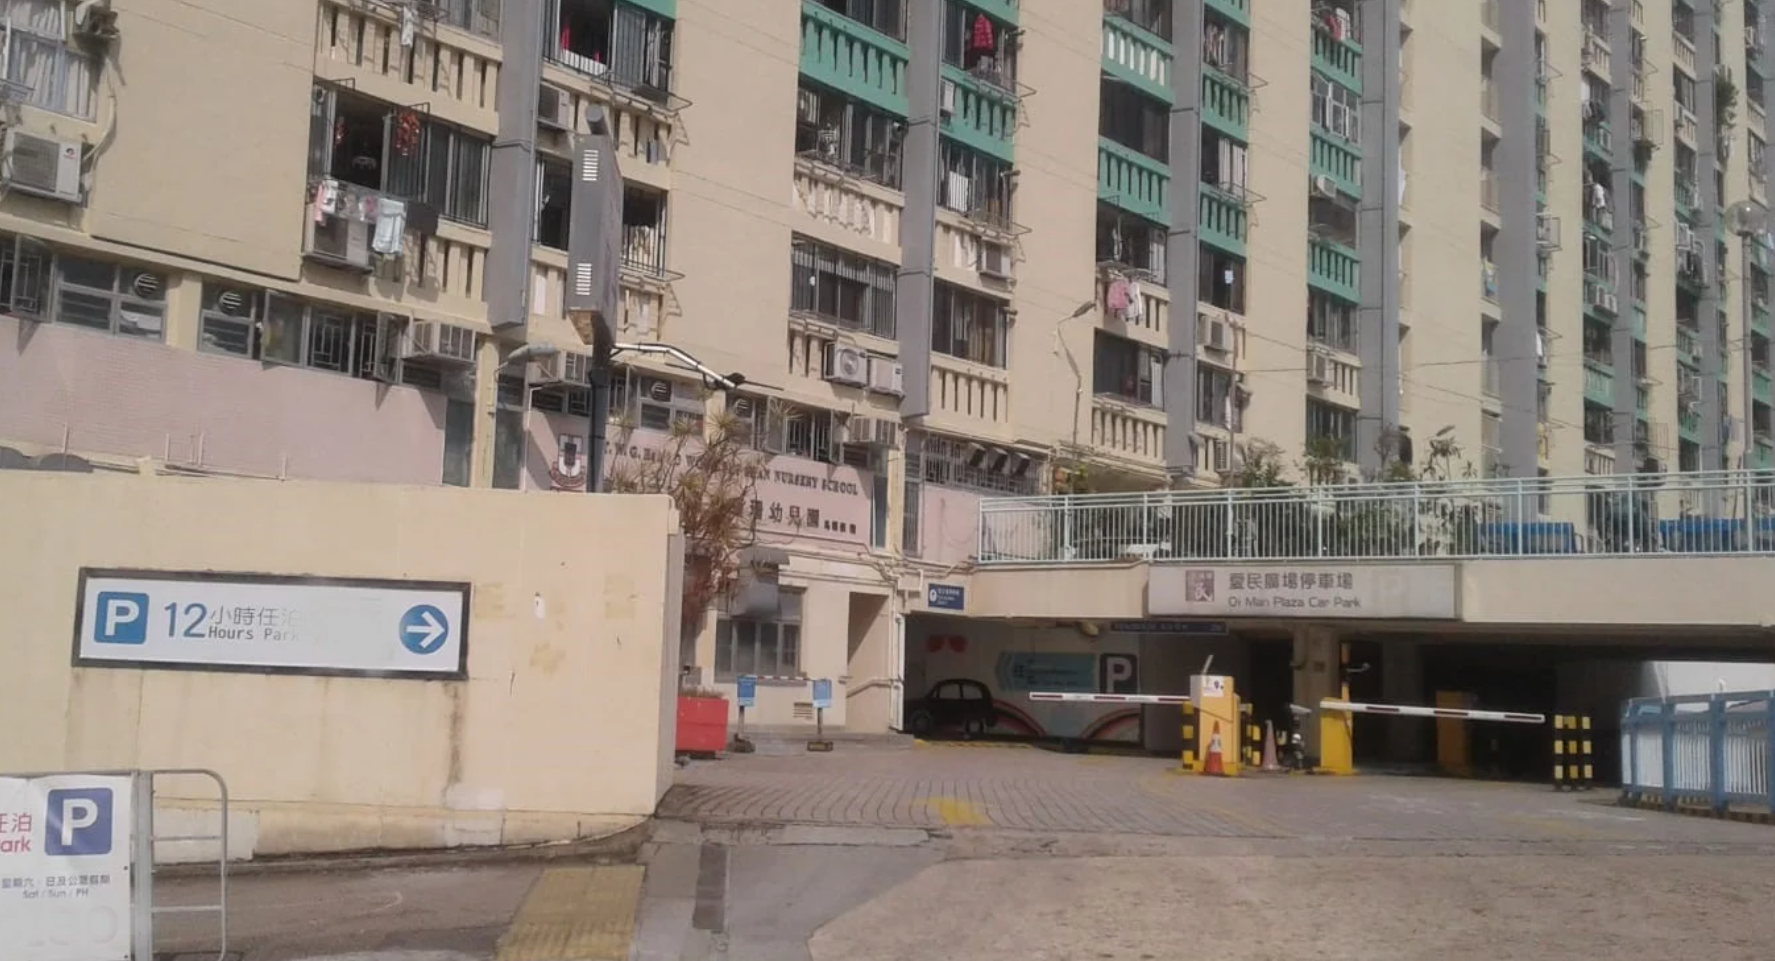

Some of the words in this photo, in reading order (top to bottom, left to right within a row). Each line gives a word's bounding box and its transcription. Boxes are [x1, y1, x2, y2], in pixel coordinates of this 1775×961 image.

[774, 470, 818, 489] NURSERY
[821, 478, 858, 496] SCHOOL
[1229, 572, 1353, 590] 愛民廣場停車場
[1228, 596, 1241, 608] Oi
[1245, 596, 1270, 608] Man
[1273, 596, 1305, 608] Plaza
[1309, 596, 1329, 608] Car
[1334, 596, 1361, 608] Park
[105, 599, 140, 636] P
[164, 602, 207, 638] 12
[208, 626, 254, 640] Hours
[1106, 657, 1132, 692] P
[61, 798, 98, 846] P
[0, 835, 32, 852] ark
[76, 887, 89, 898] PH
